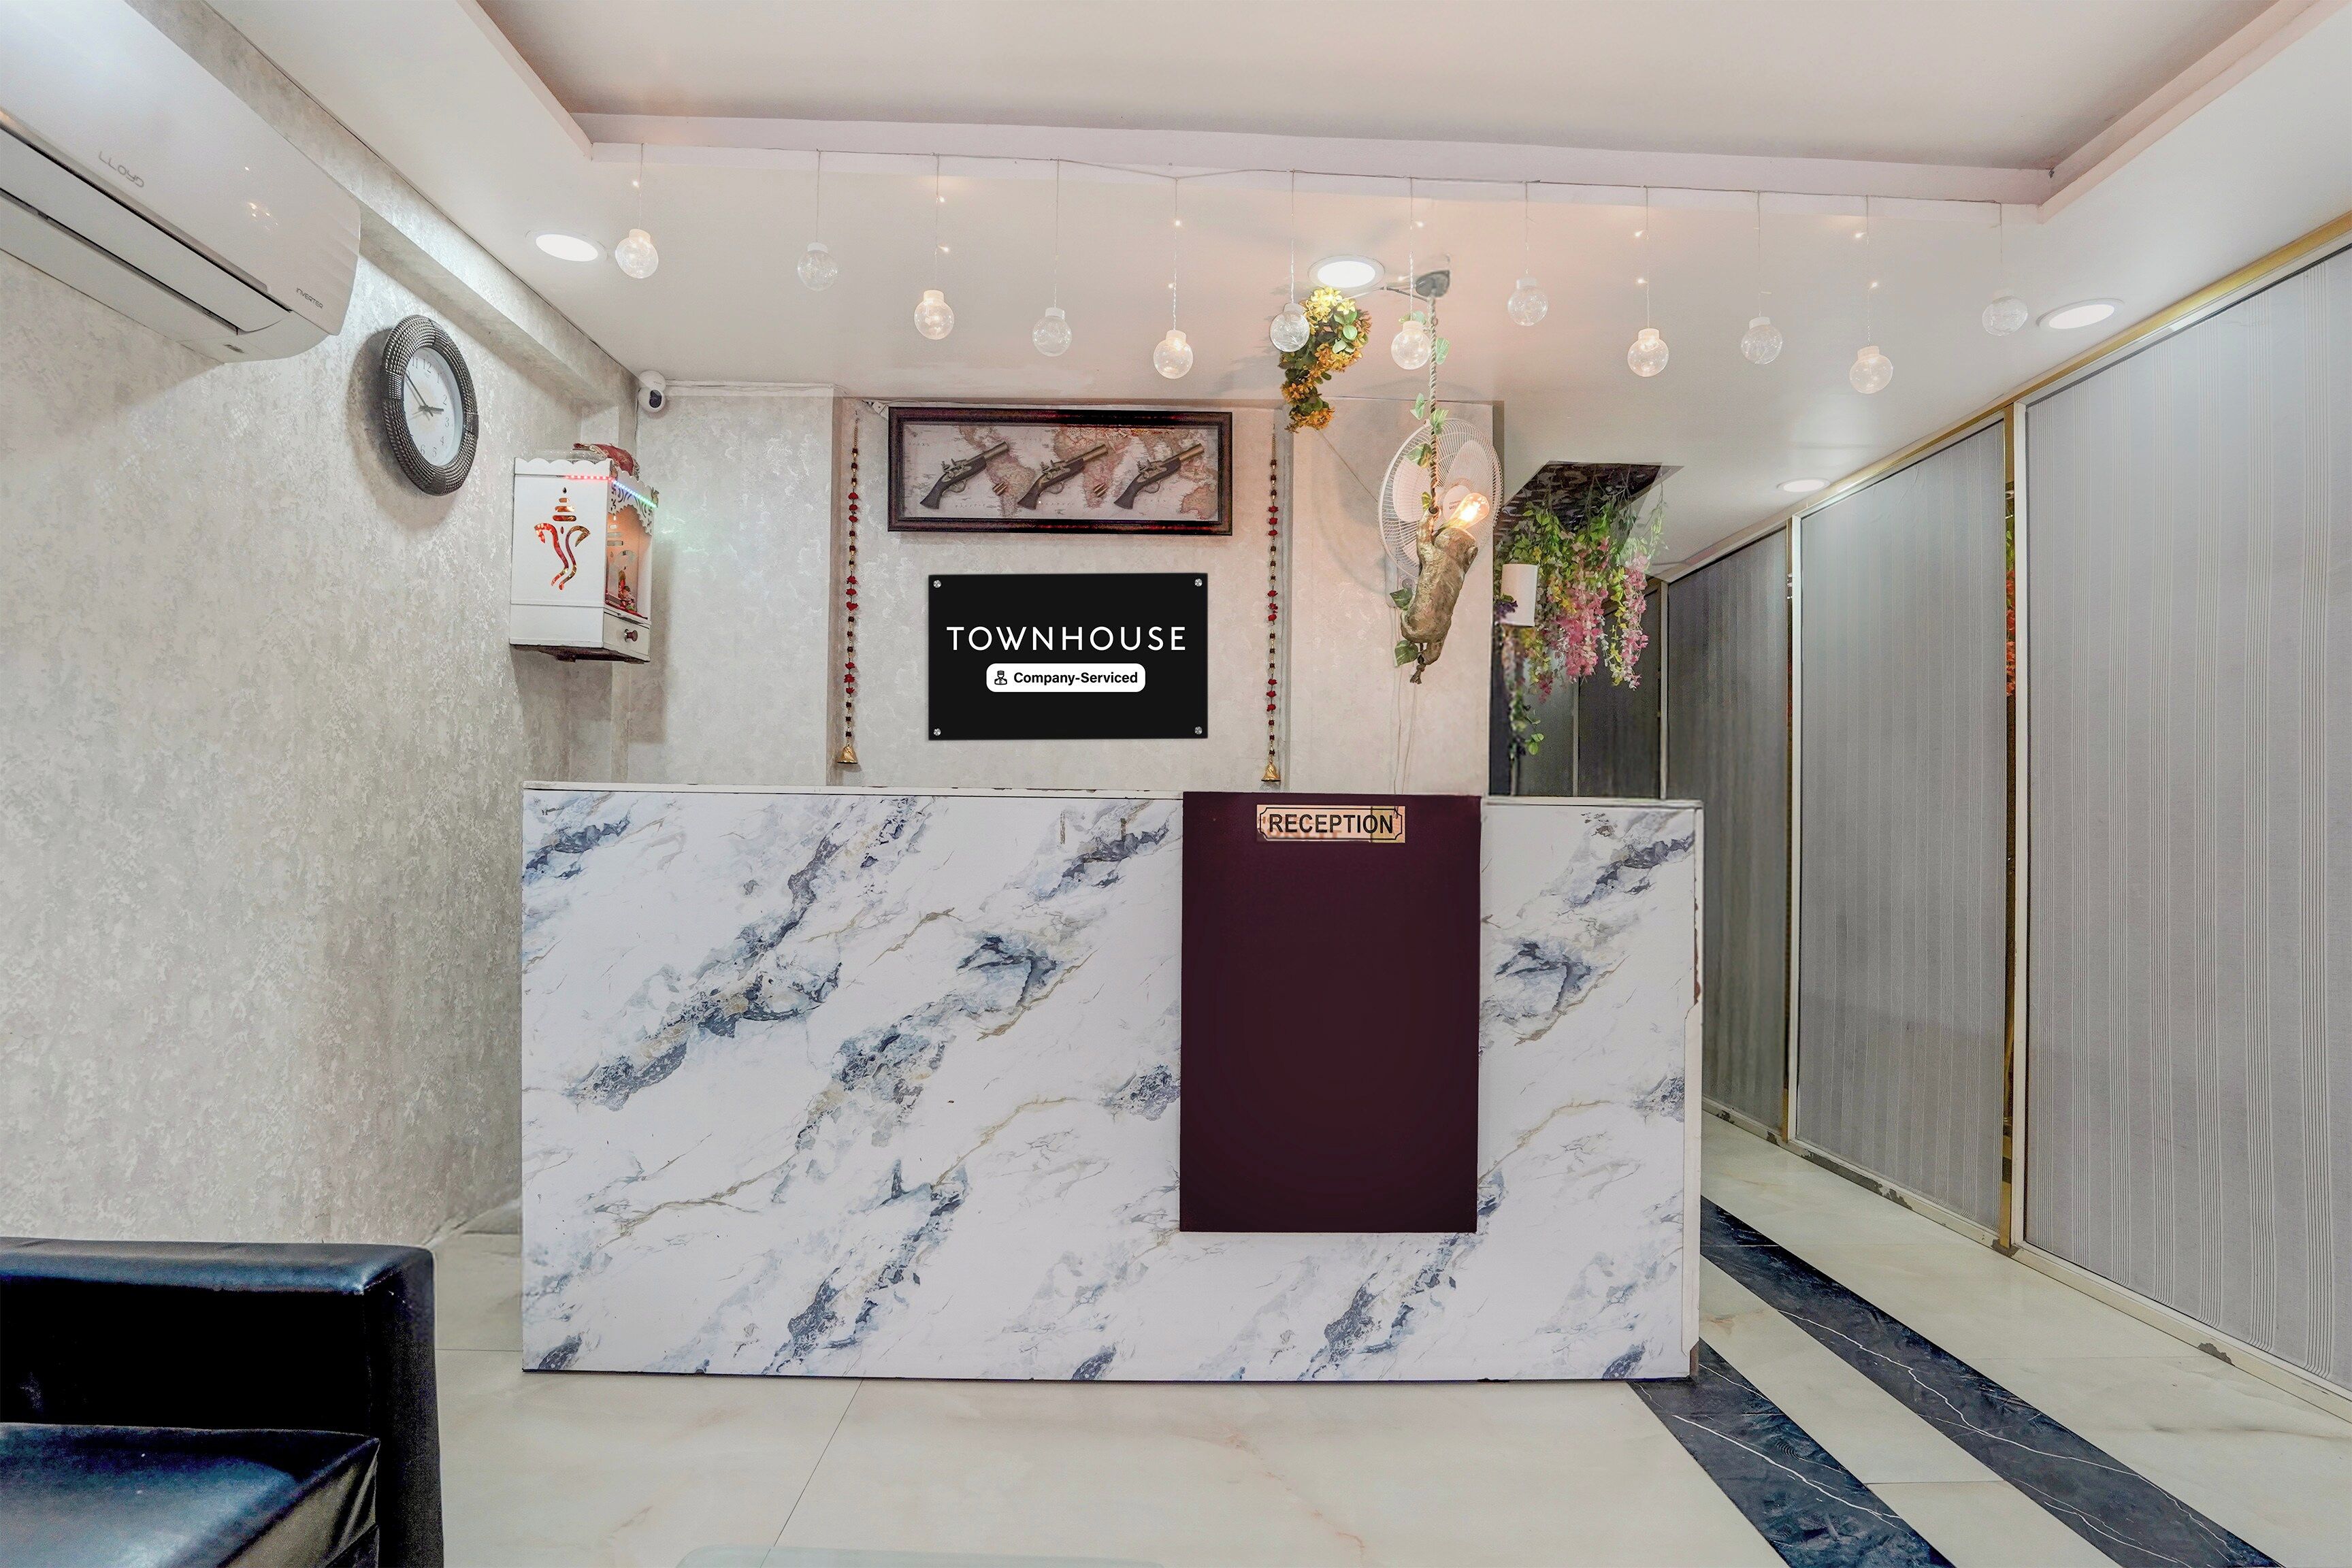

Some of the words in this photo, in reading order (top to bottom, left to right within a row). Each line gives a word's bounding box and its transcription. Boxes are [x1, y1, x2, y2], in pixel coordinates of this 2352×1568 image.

[99, 151, 145, 187] LLOYD
[423, 358, 431, 374] 12
[442, 394, 448, 406] 2
[444, 416, 450, 428] 3
[420, 444, 425, 455] 6
[946, 625, 1186, 651] TOWNHOUSE
[1013, 672, 1138, 686] Company-Serviced
[1269, 813, 1394, 834] RECEPTION
